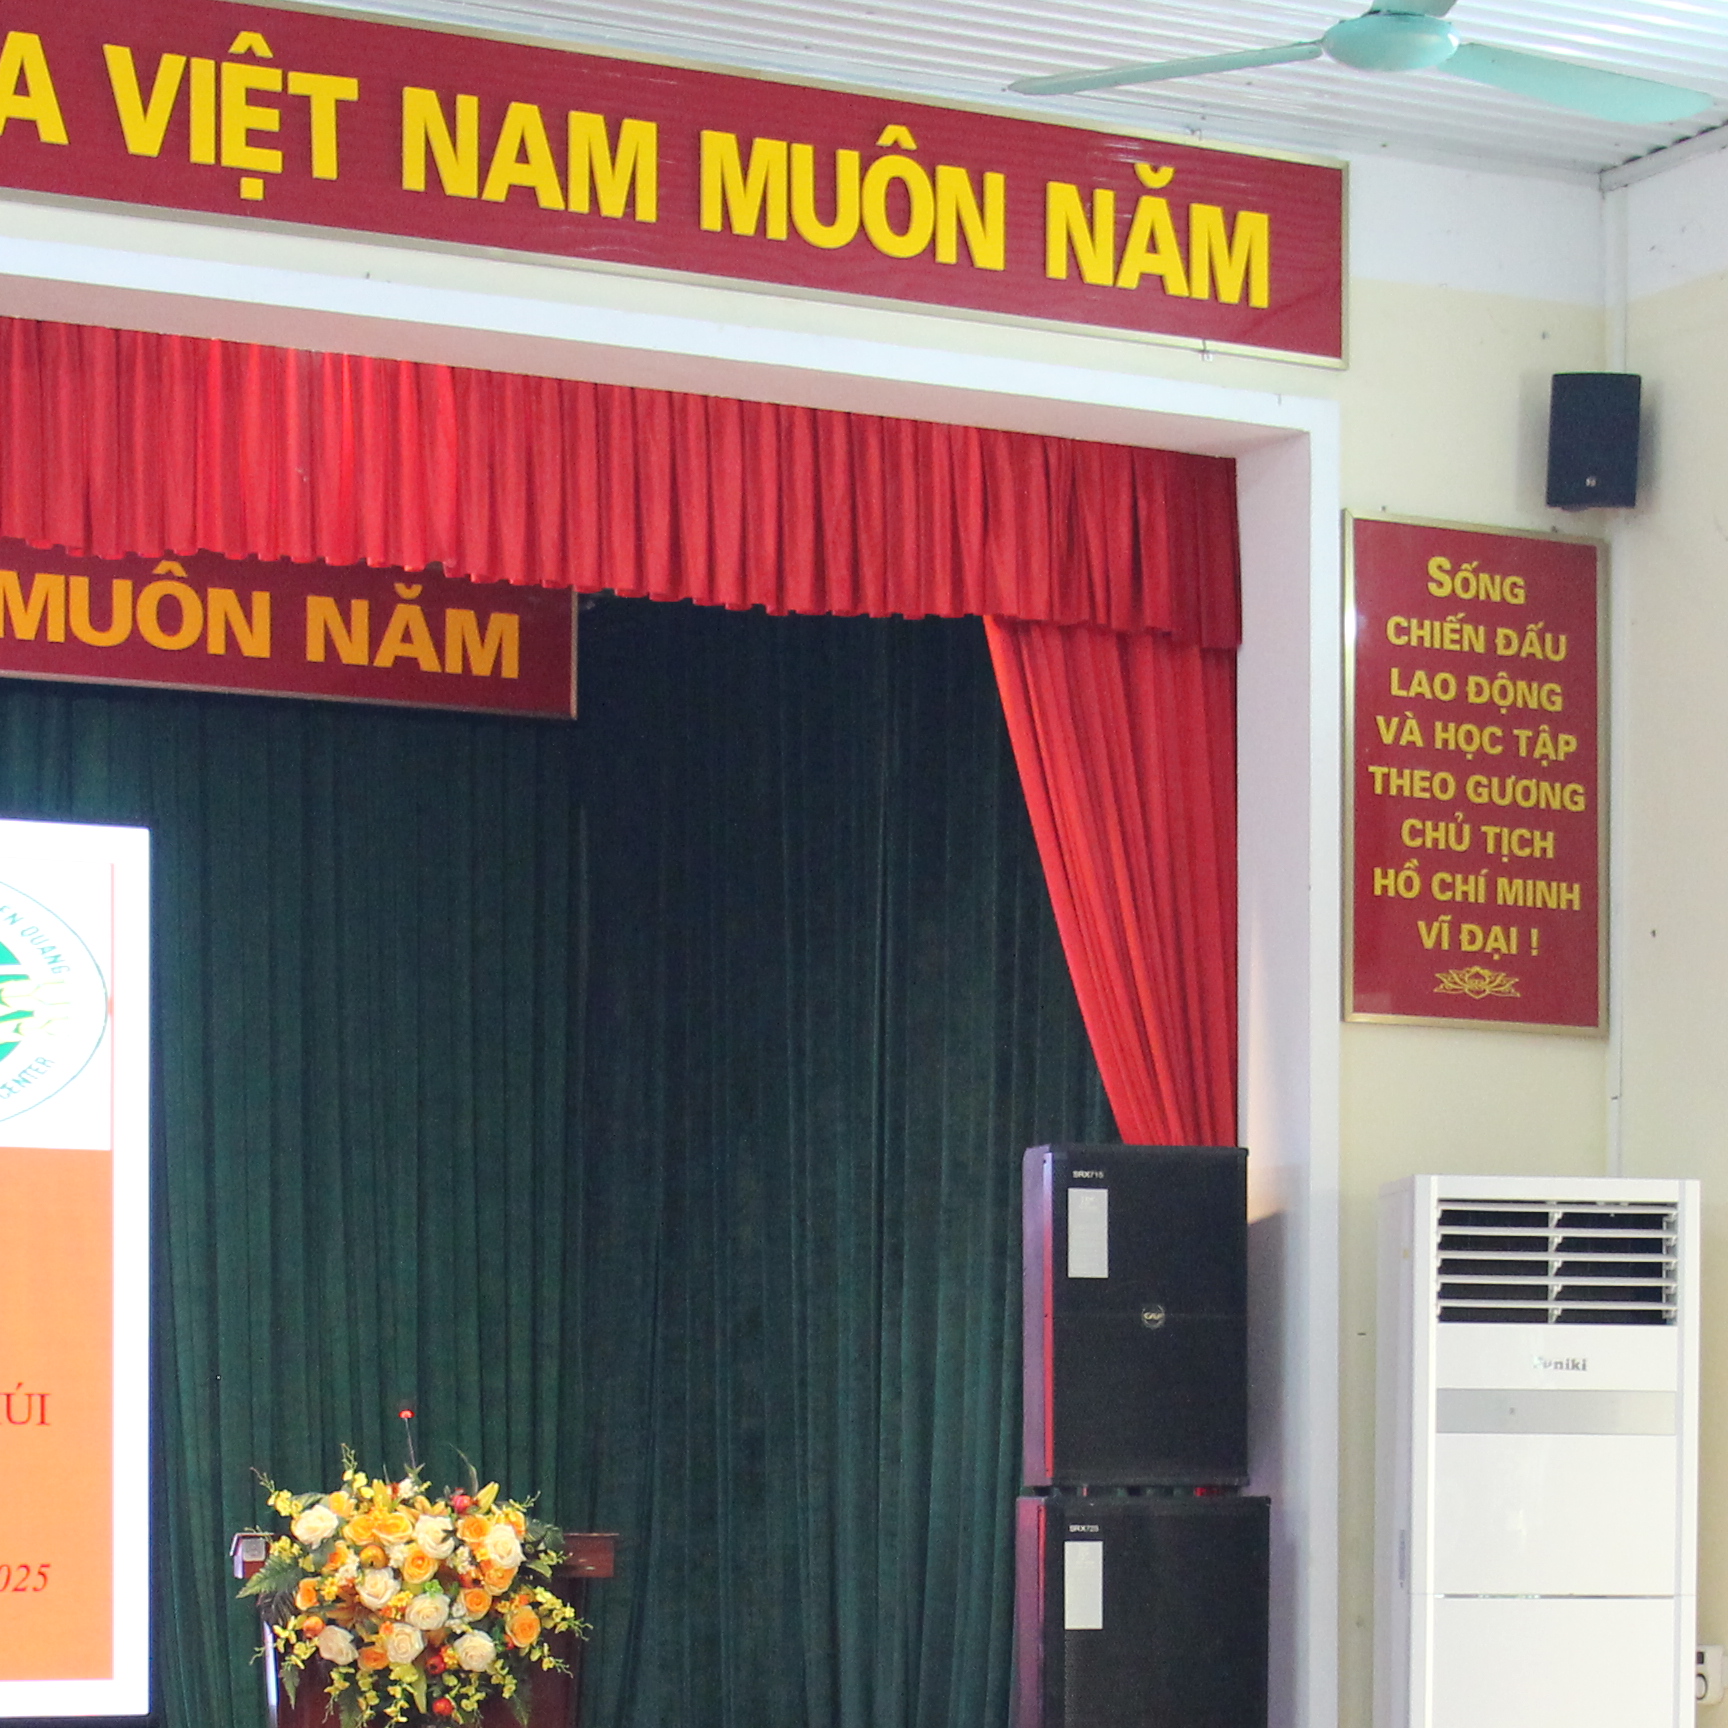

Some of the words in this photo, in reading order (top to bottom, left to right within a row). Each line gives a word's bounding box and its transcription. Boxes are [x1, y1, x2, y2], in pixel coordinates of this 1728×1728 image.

[104, 32, 360, 200] VIỆT
[403, 88, 660, 224] NAM
[701, 125, 1008, 272] MUÔN
[1047, 163, 1272, 309] NĂM
[1429, 558, 1527, 605] SỐNG
[309, 585, 520, 679] NĂM
[1388, 614, 1487, 654] CHIẾN
[1497, 624, 1568, 662] ĐẤU
[1392, 669, 1458, 701] LAO
[1467, 673, 1564, 714] ĐỘNG
[1378, 713, 1425, 748] VÀ
[1436, 723, 1504, 760] HỌC
[1515, 726, 1578, 767] TẬP
[1370, 767, 1457, 801] THEO
[1467, 776, 1586, 812] GƯƠNG
[1403, 814, 1472, 852] CHỦ
[1482, 827, 1555, 863] TỊCH
[1375, 860, 1422, 899] HỒ
[1433, 871, 1487, 904] CHÍ
[1498, 878, 1581, 911] MINH
[1419, 916, 1453, 950] VĨ
[1461, 925, 1519, 961] ĐẠI
